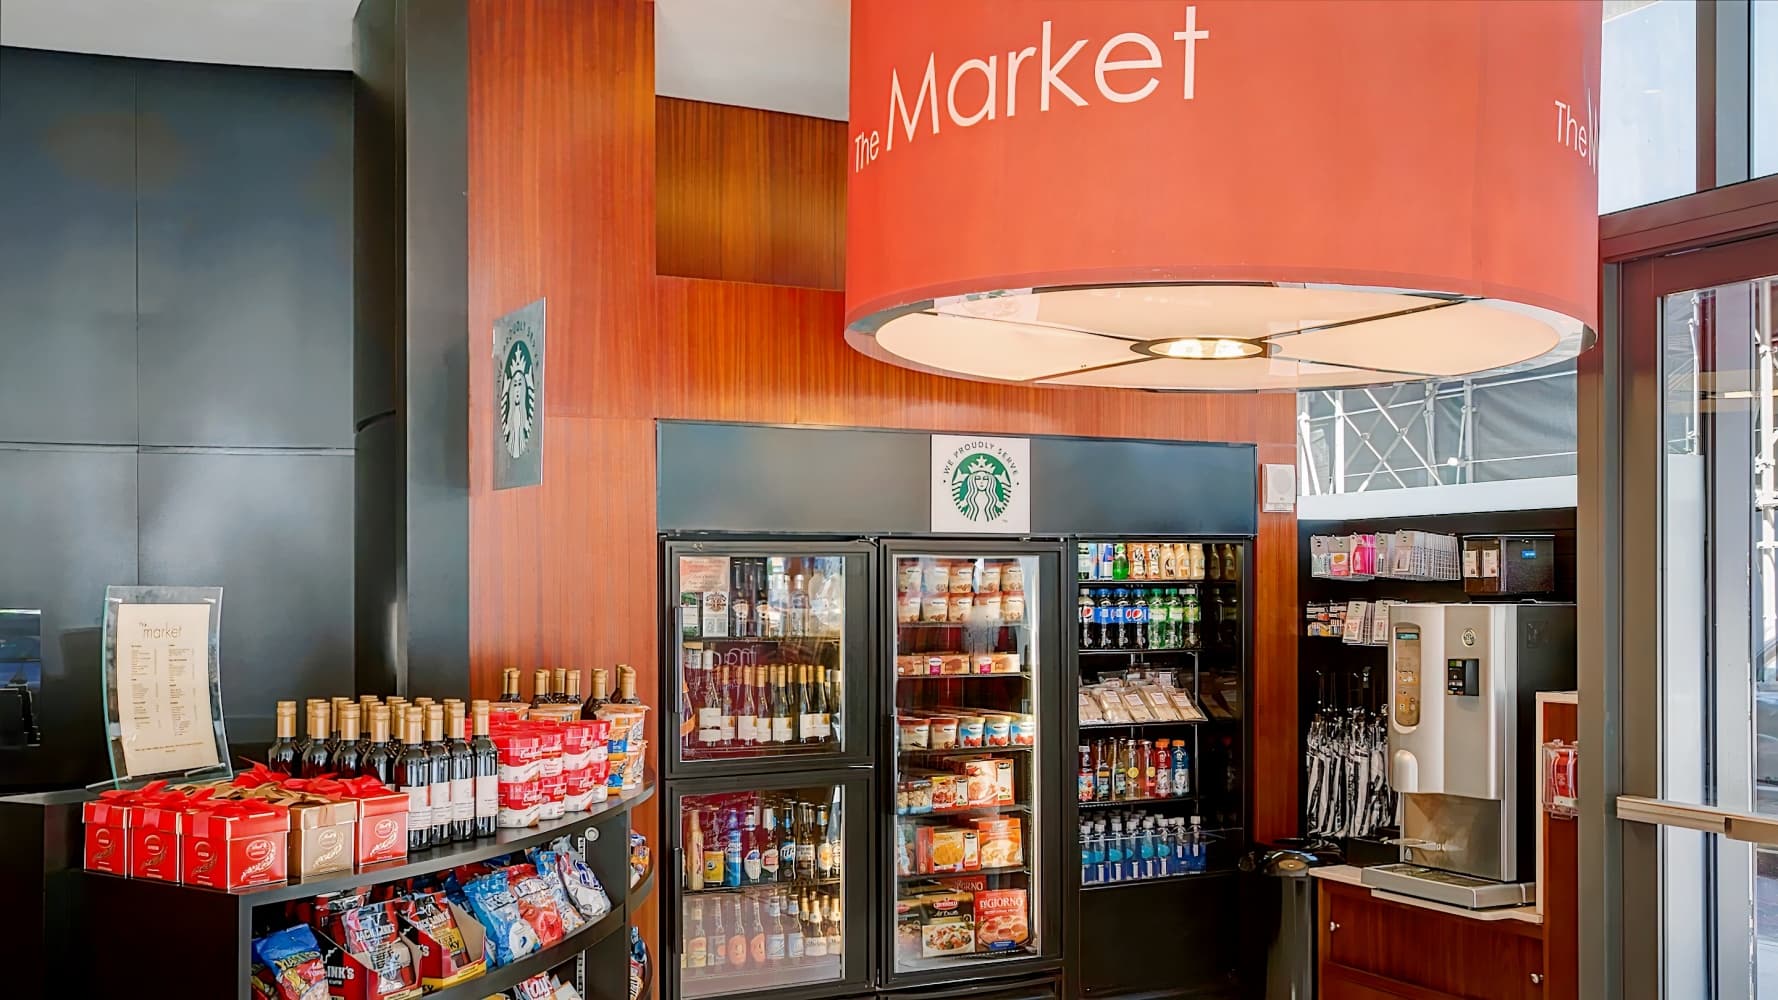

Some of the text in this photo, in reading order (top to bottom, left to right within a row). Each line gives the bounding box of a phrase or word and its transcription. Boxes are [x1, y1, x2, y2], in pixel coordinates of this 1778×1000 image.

[855, 5, 1209, 173] The Market
[1554, 99, 1587, 157] The
[943, 441, 1018, 475] WE PROUDLY SERVE
[143, 622, 182, 640] market
